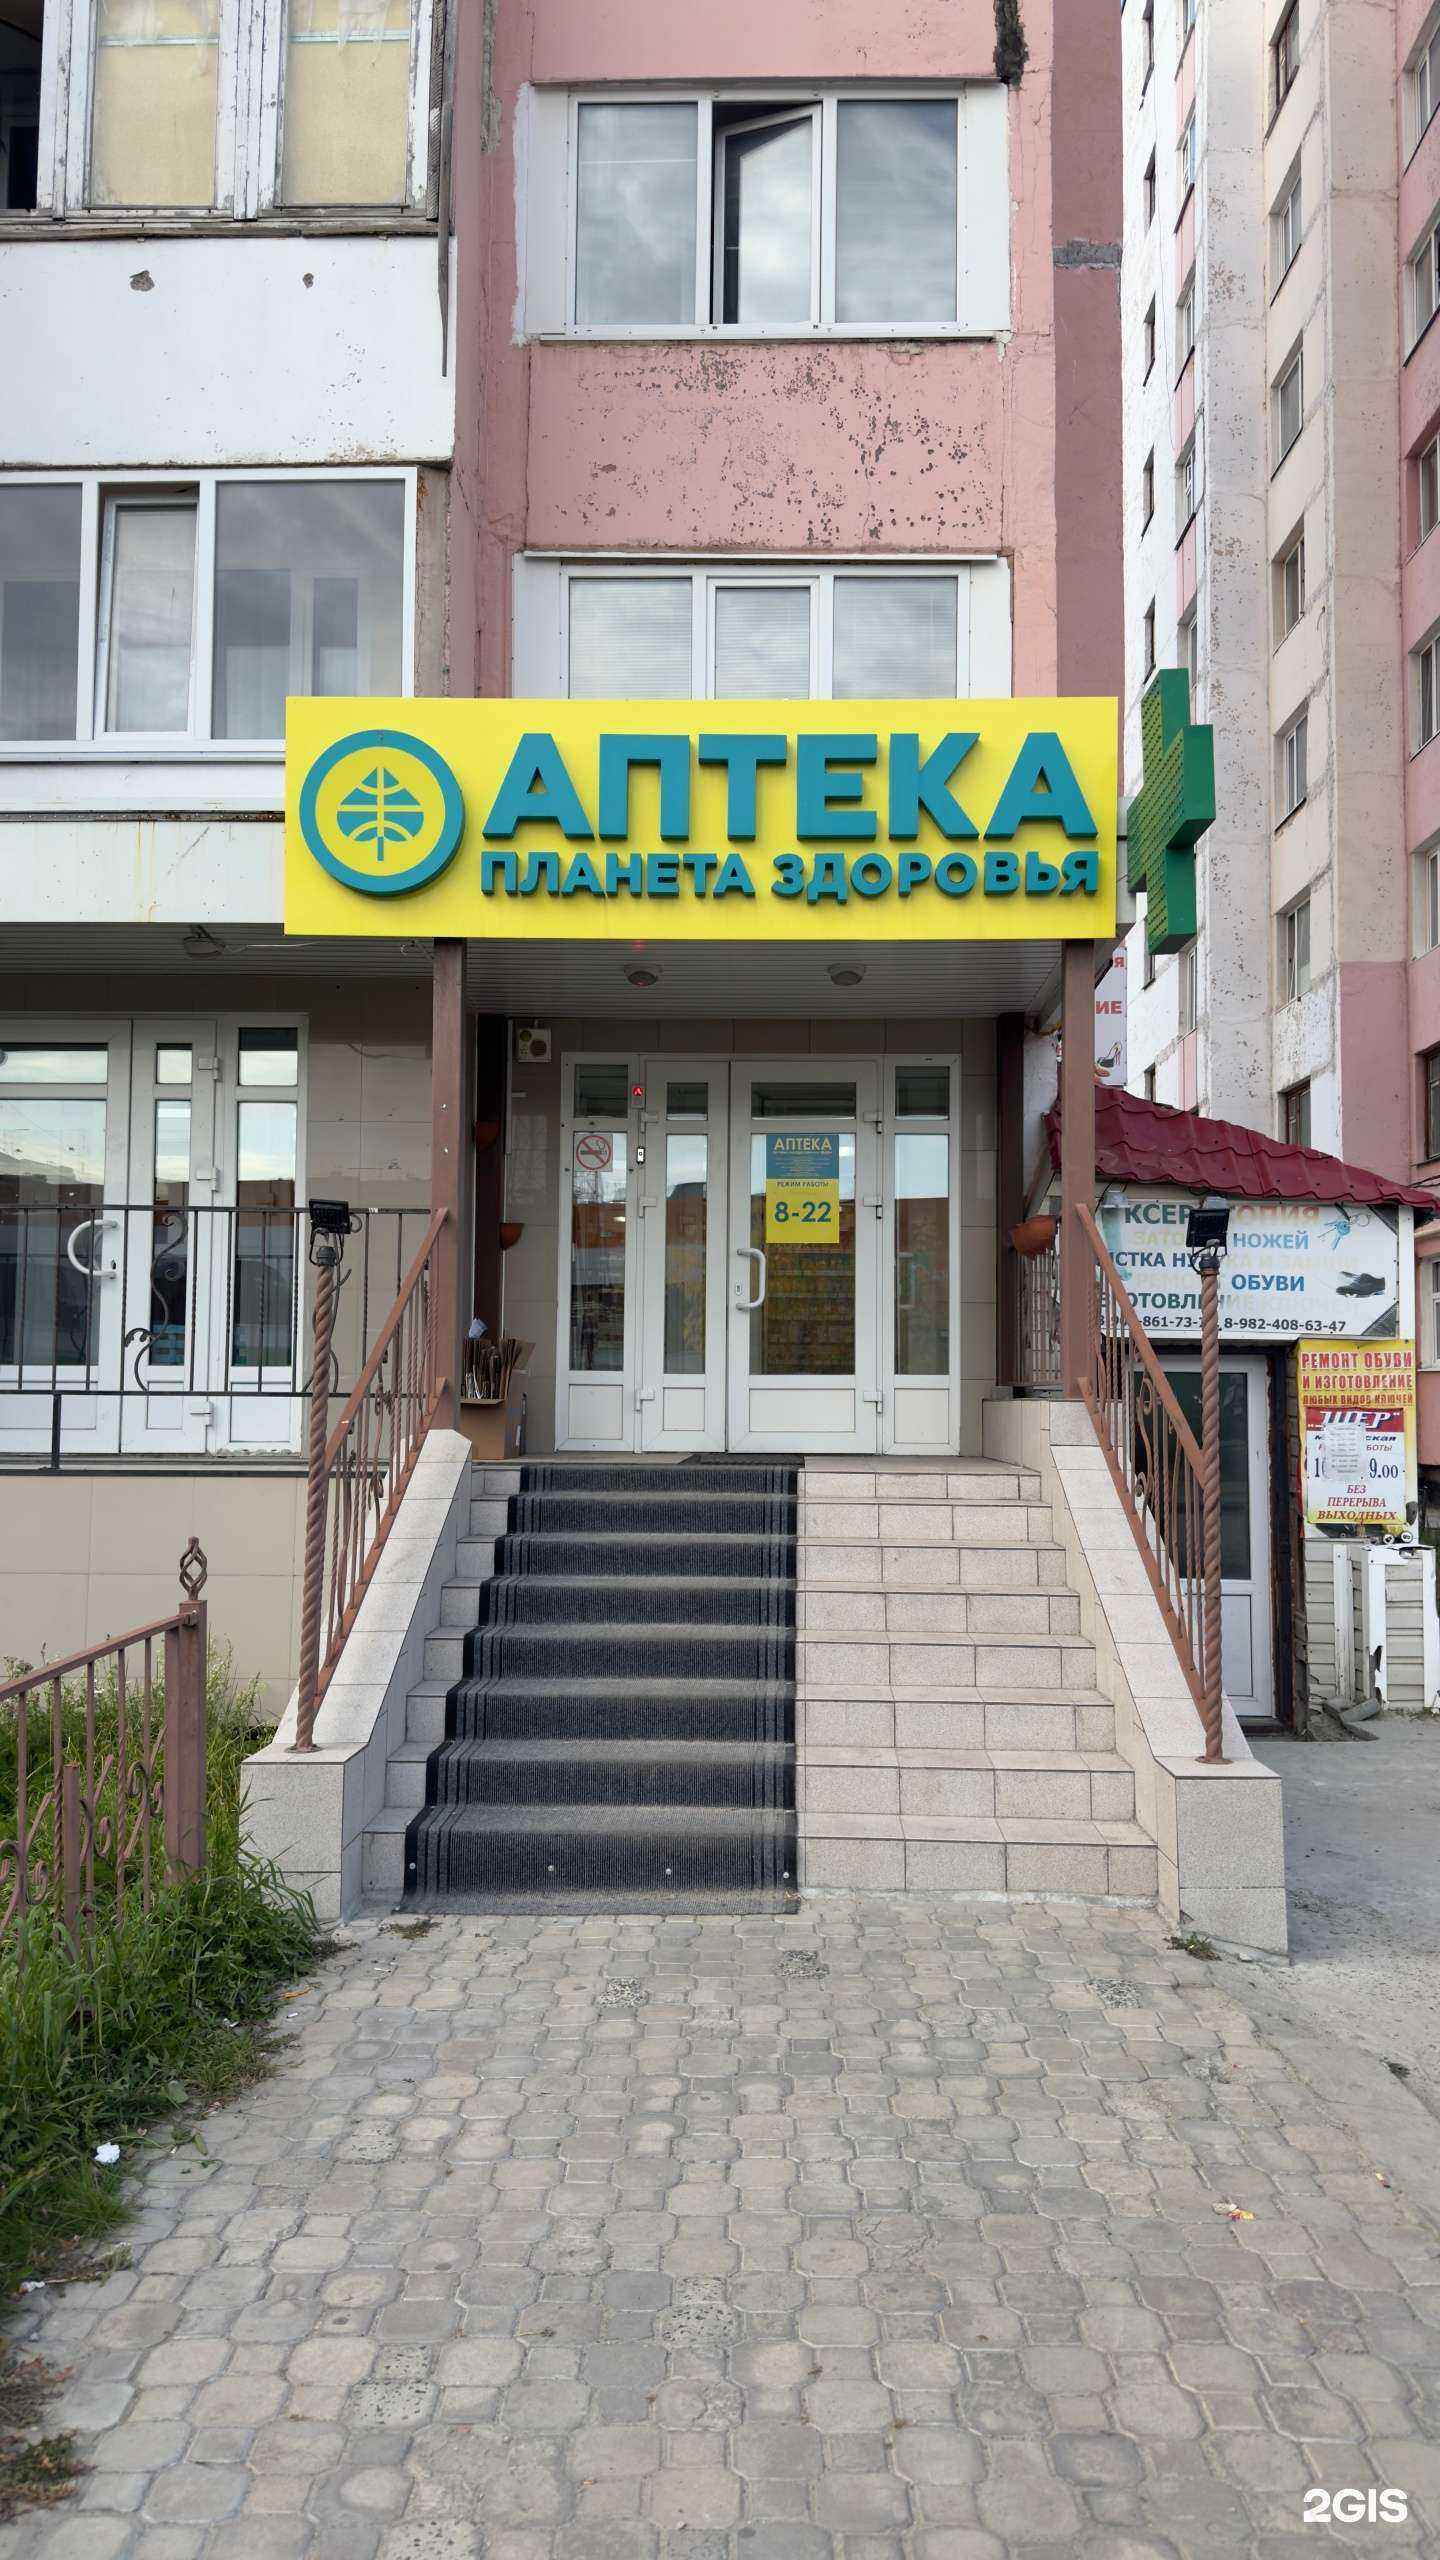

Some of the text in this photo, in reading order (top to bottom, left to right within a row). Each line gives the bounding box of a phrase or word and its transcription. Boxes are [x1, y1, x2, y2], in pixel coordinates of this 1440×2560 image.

[482, 732, 1099, 841] АПТЕКА
[481, 851, 1100, 905] ПЛАНЕТА ЗДОРОВЬЯ
[774, 1137, 832, 1151] АПТЕКА
[774, 1201, 832, 1223] 8-22
[1125, 1204, 1320, 1225] КСЕРОПИЯ
[1233, 1230, 1309, 1249] НОЖЕЙ
[1231, 1273, 1305, 1292] ОБУВИ
[1224, 1317, 1346, 1332] 8-982-408-63-47
[1301, 1352, 1412, 1368] РЕМОНТ ОБУВИ
[1302, 1374, 1412, 1389] И ИЗГОТОВЛЕНИЕ
[1347, 1485, 1366, 1494] БЕЗ
[1328, 1497, 1386, 1507] ПЕРЕРЫВА
[1317, 1511, 1397, 1521] ВЫХОДНЫХ
